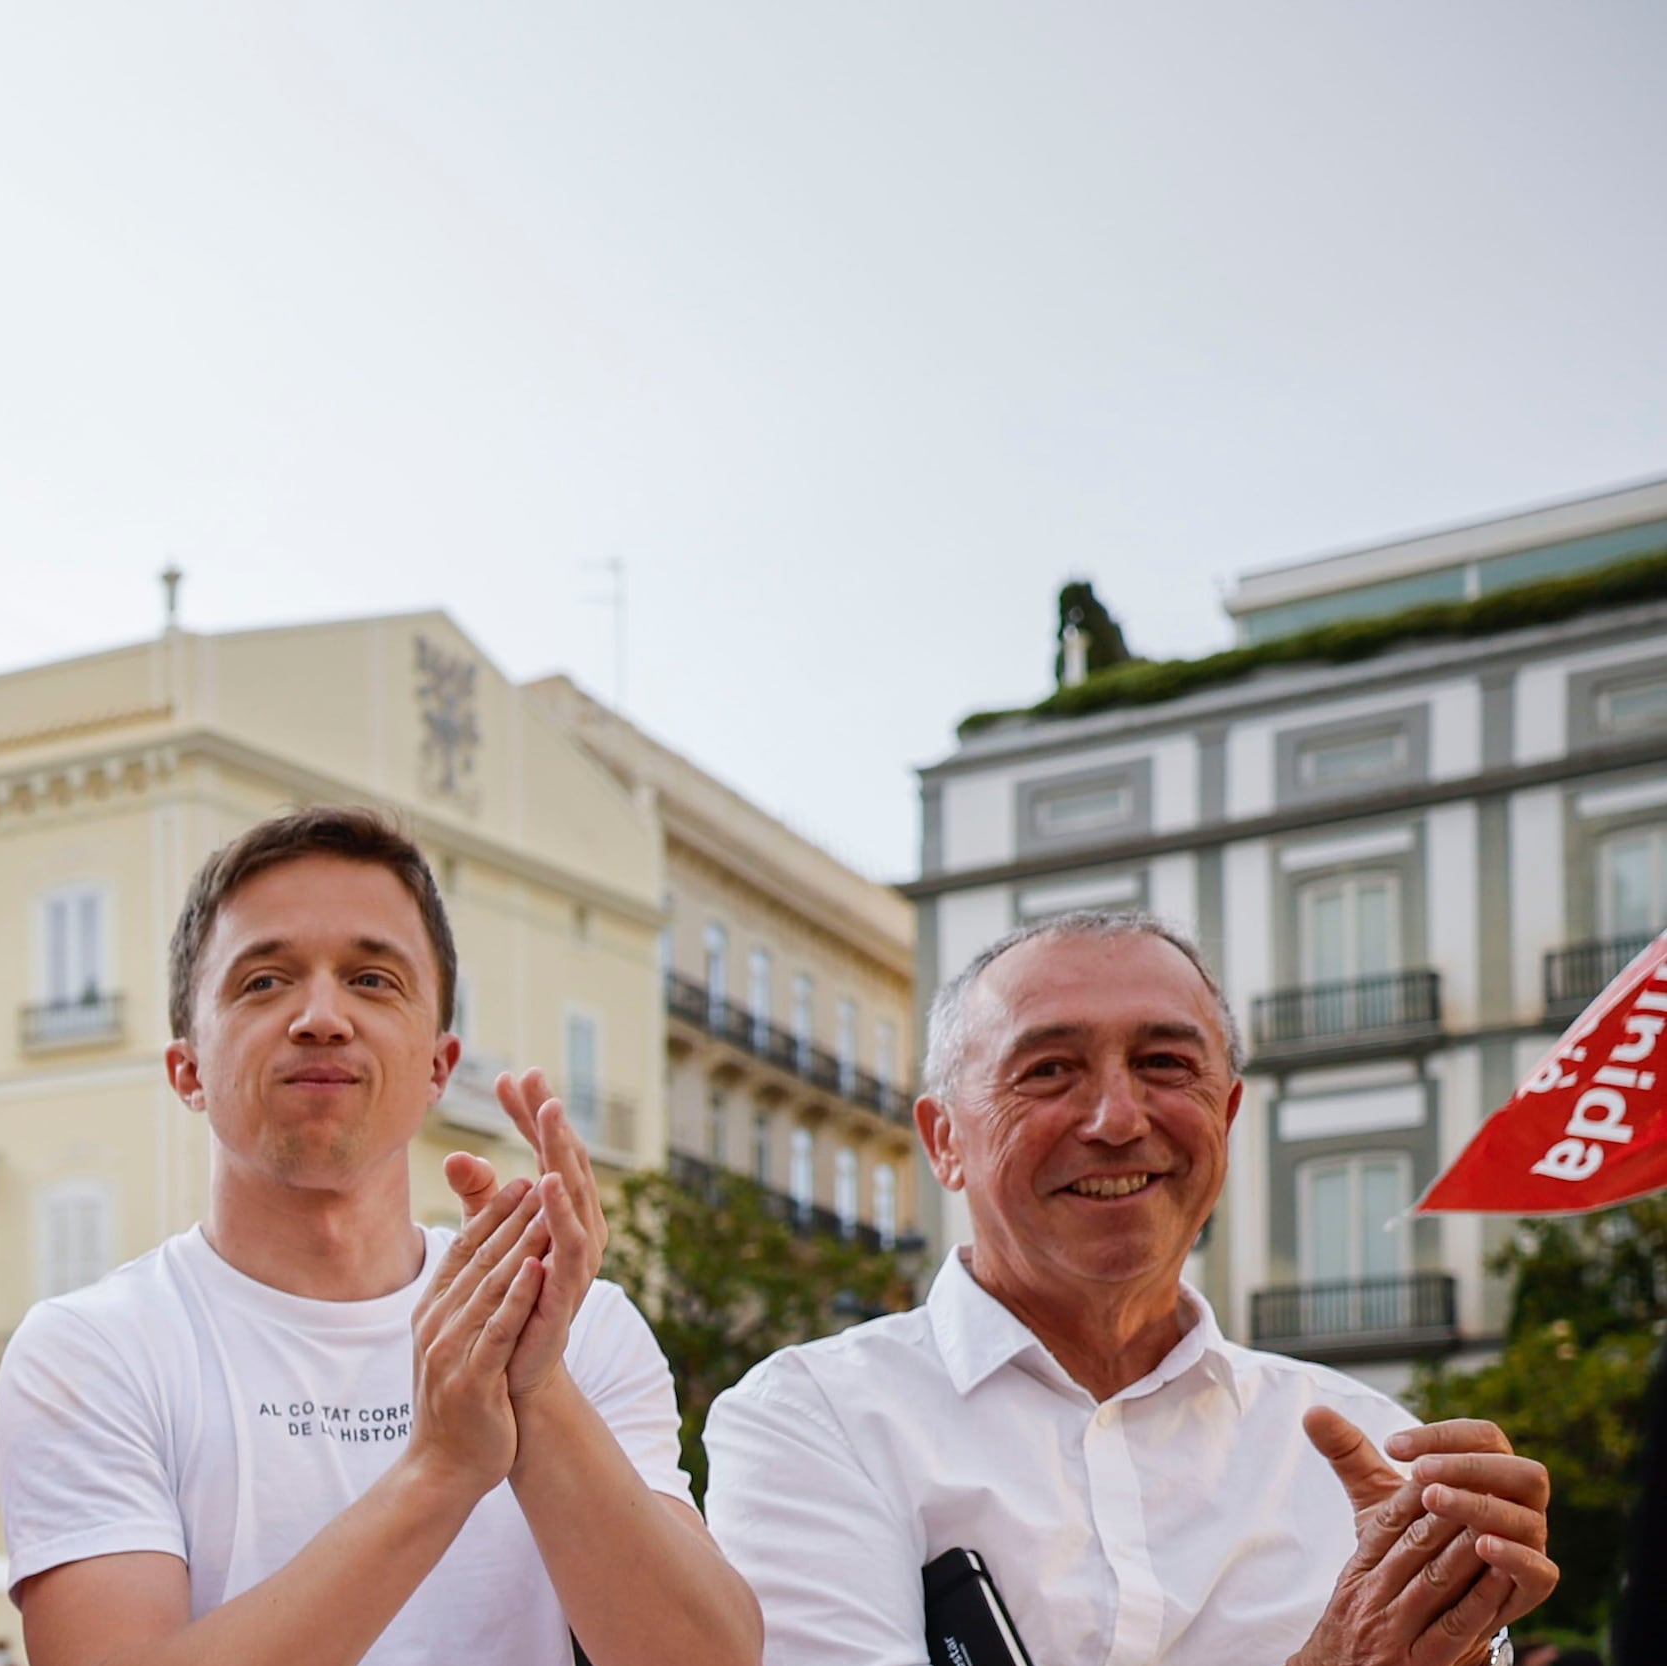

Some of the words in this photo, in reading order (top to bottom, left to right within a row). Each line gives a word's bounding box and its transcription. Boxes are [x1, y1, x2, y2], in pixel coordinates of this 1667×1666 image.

[259, 1402, 282, 1416] AL
[289, 1400, 351, 1422] COTAT
[359, 1402, 411, 1422] CORR
[289, 1421, 312, 1436] DE
[340, 1421, 413, 1442] HISTÒR
